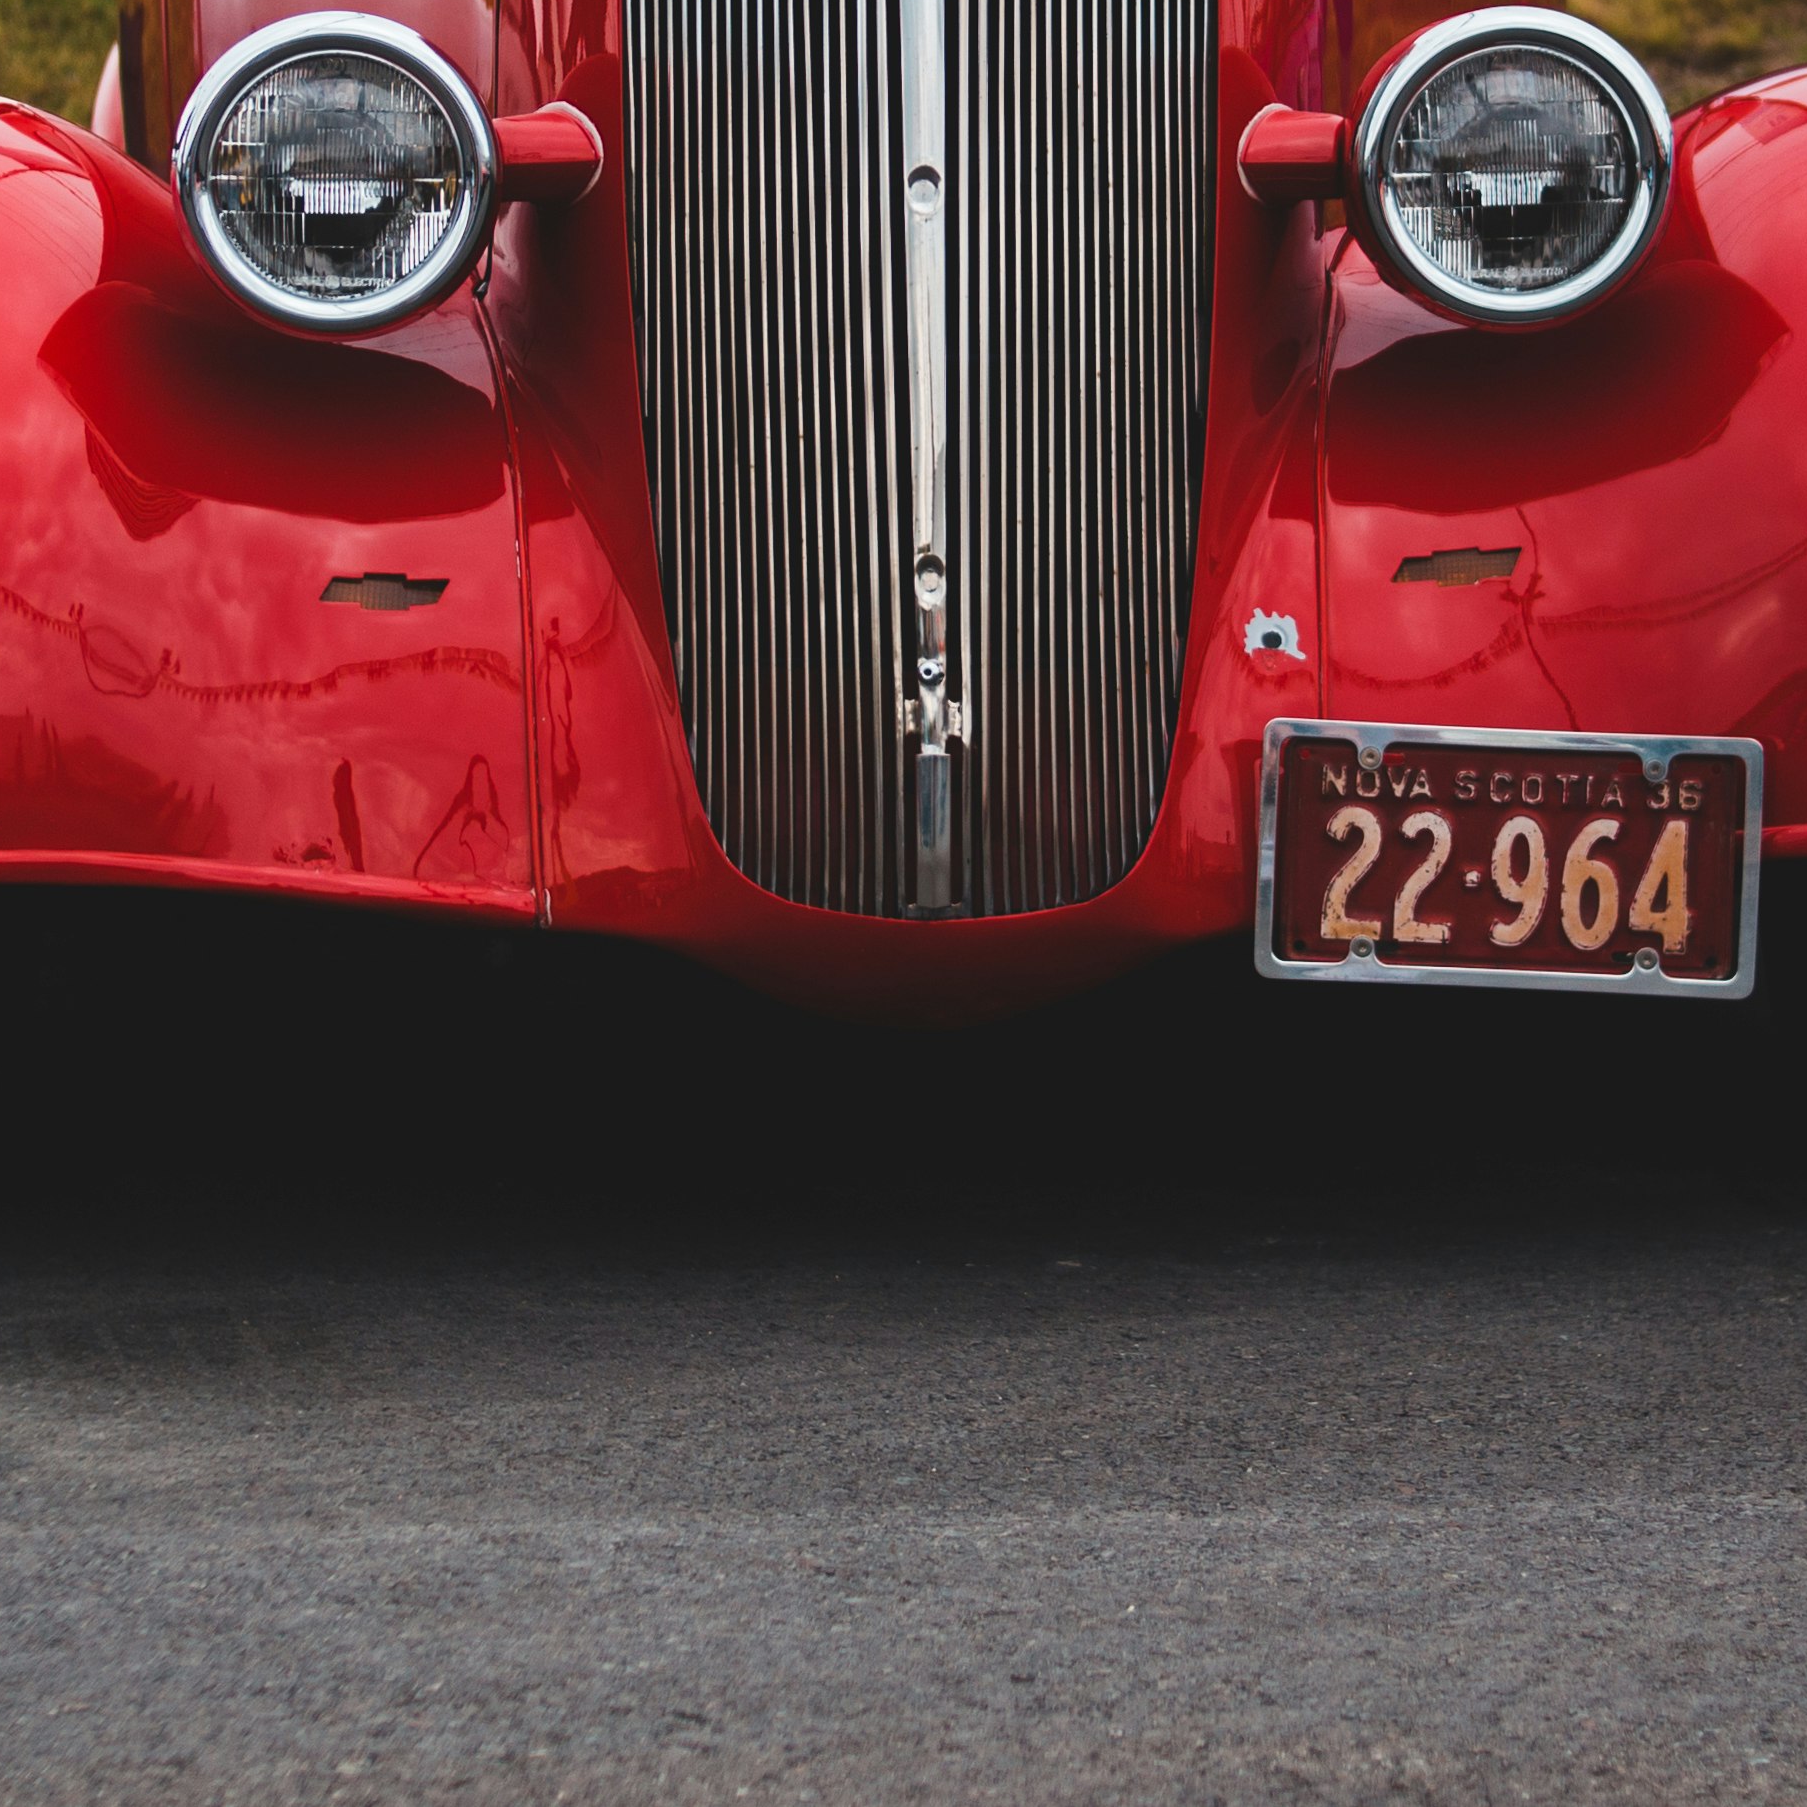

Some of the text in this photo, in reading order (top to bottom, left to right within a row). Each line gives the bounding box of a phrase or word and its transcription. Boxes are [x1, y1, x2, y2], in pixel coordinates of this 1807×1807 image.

[1321, 764, 1703, 811] NOVA SCOTIA 36
